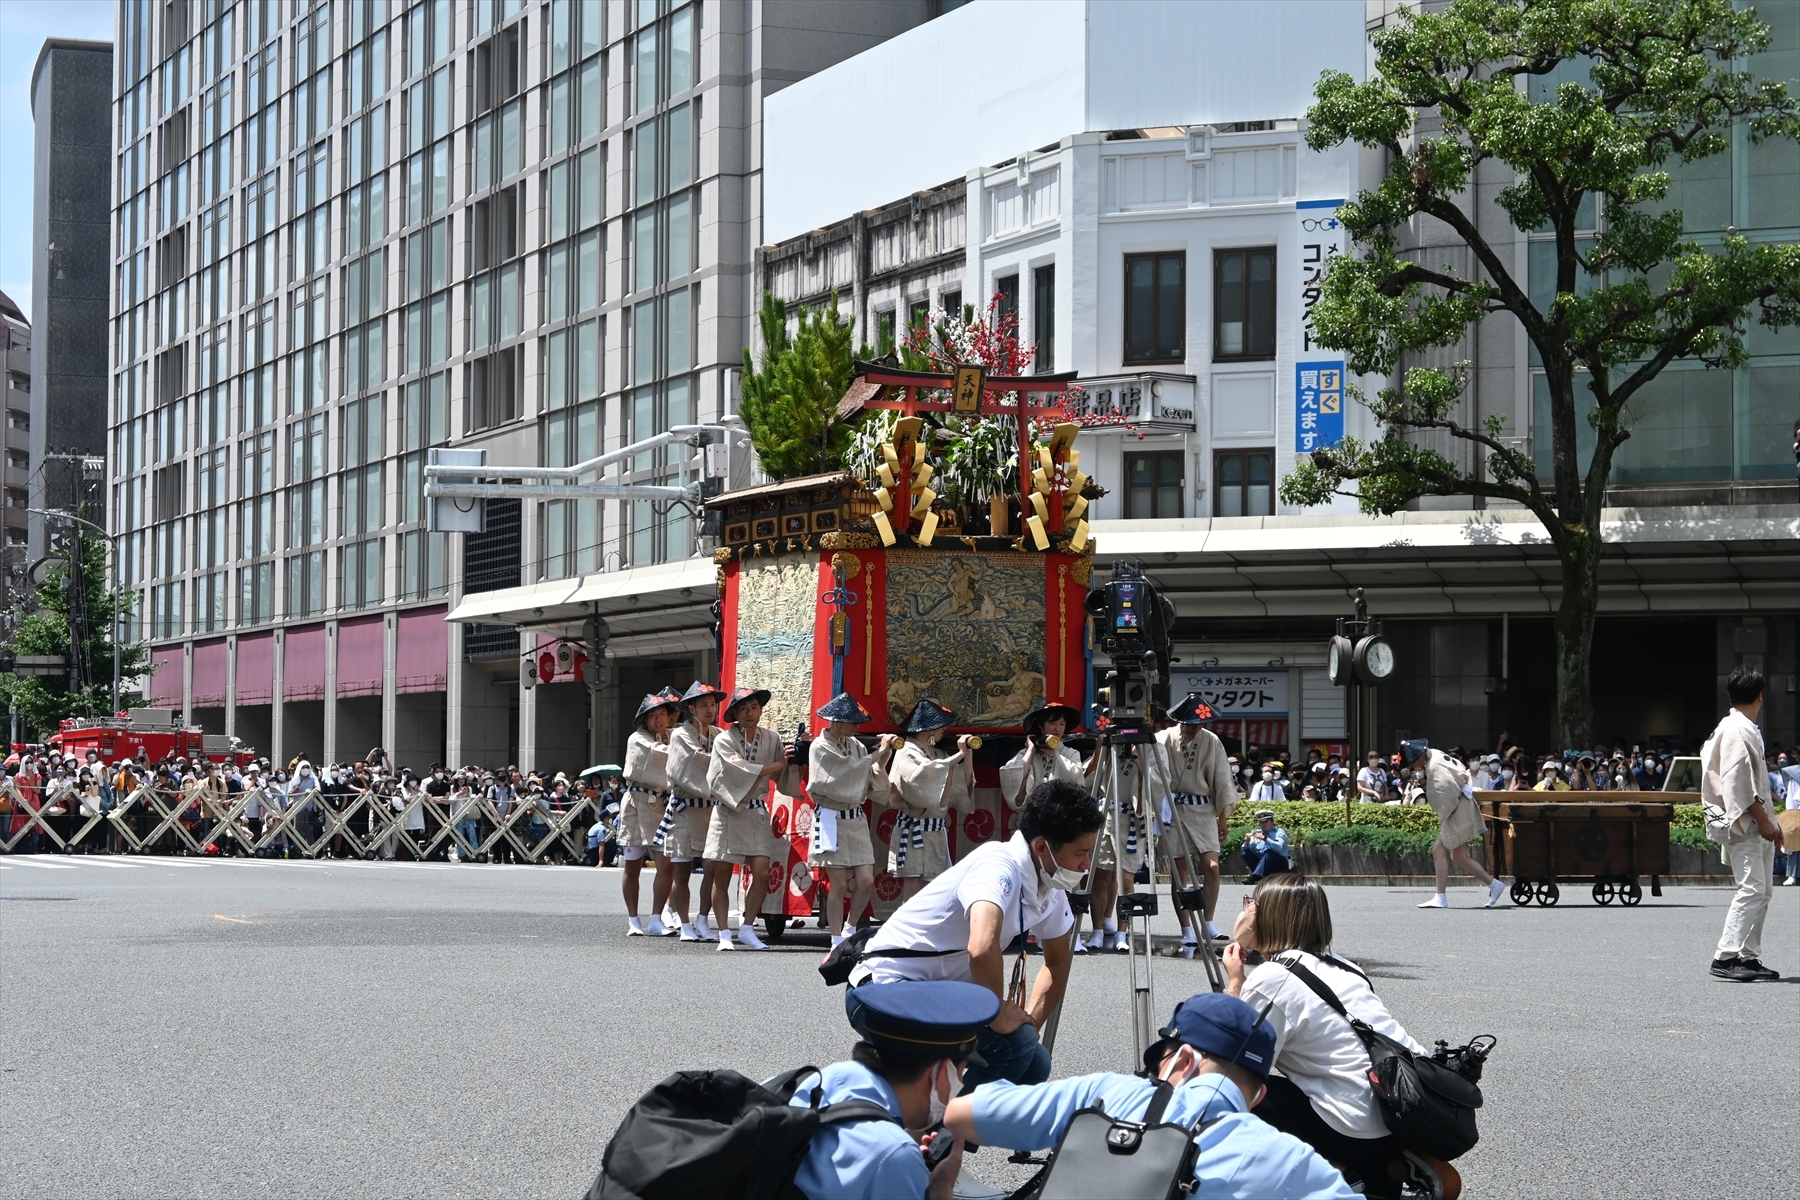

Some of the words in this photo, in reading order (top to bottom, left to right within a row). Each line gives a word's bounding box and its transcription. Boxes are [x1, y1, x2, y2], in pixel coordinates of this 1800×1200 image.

[961, 374, 976, 406] 天神
[1322, 371, 1338, 412] すぐ
[1300, 370, 1318, 450] 買えます
[1215, 677, 1274, 686] メガネスーパー
